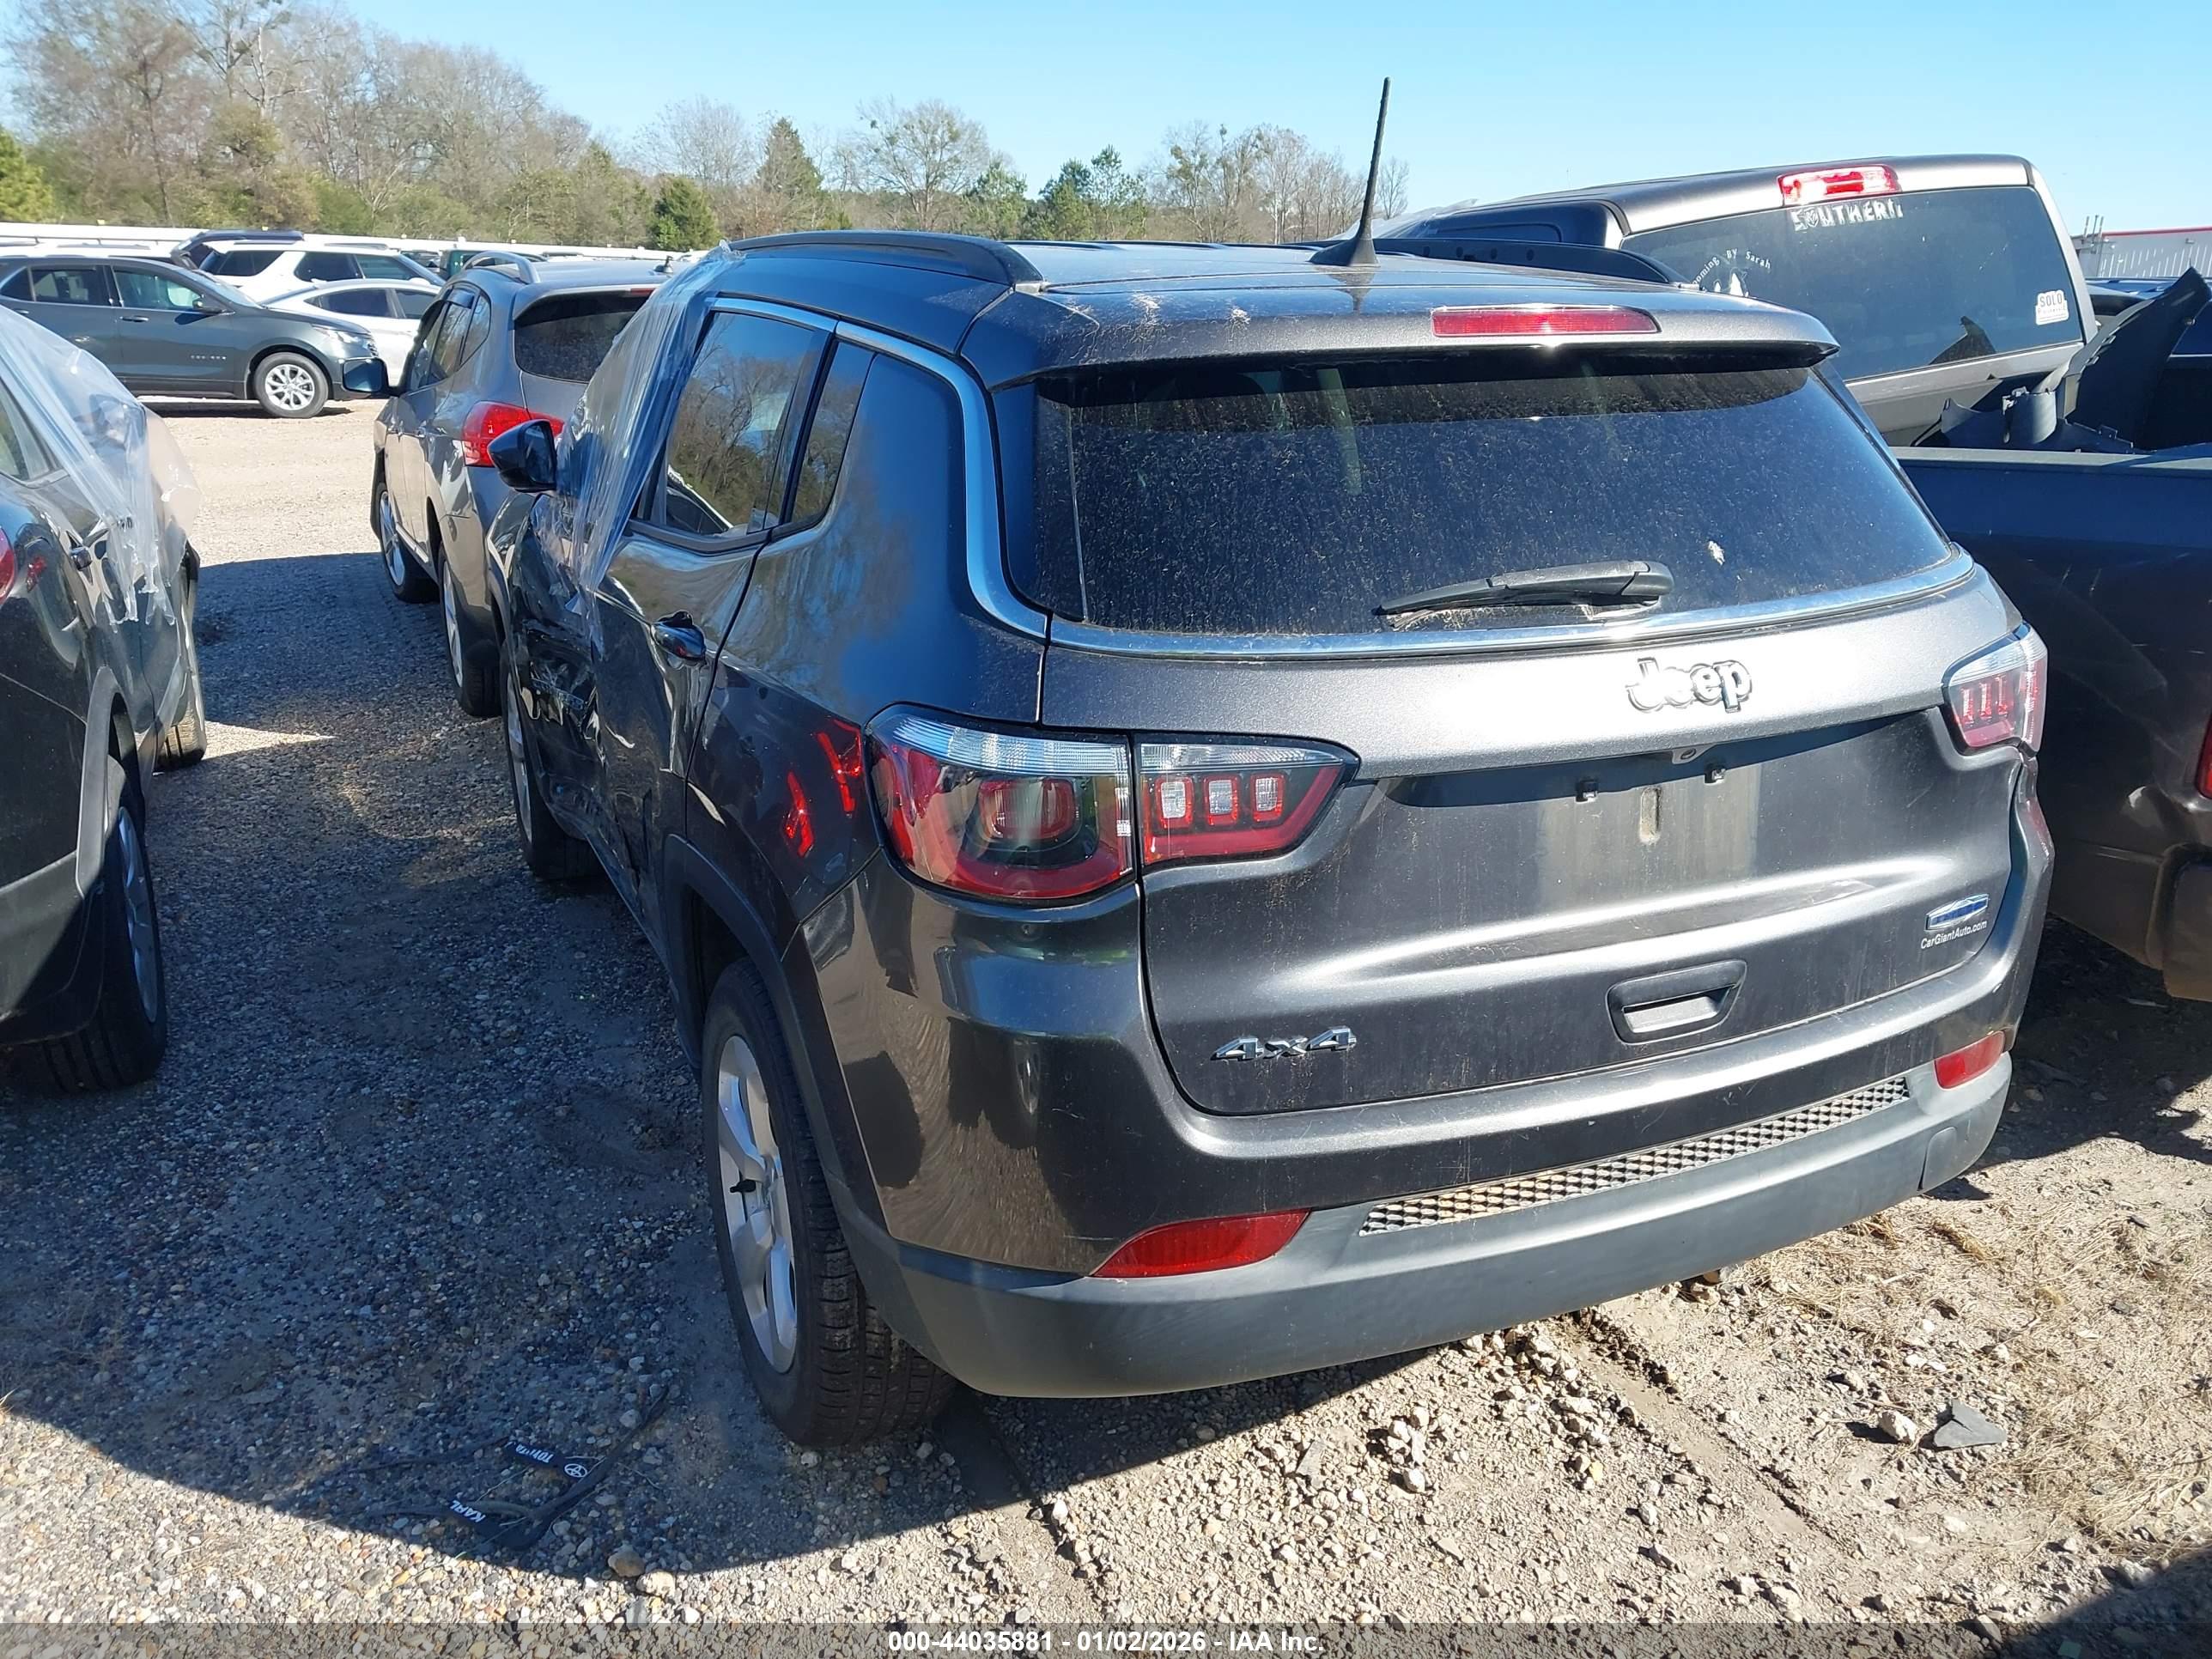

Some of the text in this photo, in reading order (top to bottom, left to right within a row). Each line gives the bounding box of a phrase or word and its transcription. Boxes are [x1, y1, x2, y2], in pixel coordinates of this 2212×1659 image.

[1745, 251, 1771, 269] Sarah
[2039, 293, 2063, 307] SOLO
[1625, 657, 1753, 714] Jeep
[1920, 921, 1988, 949] CarGiantAuto.com
